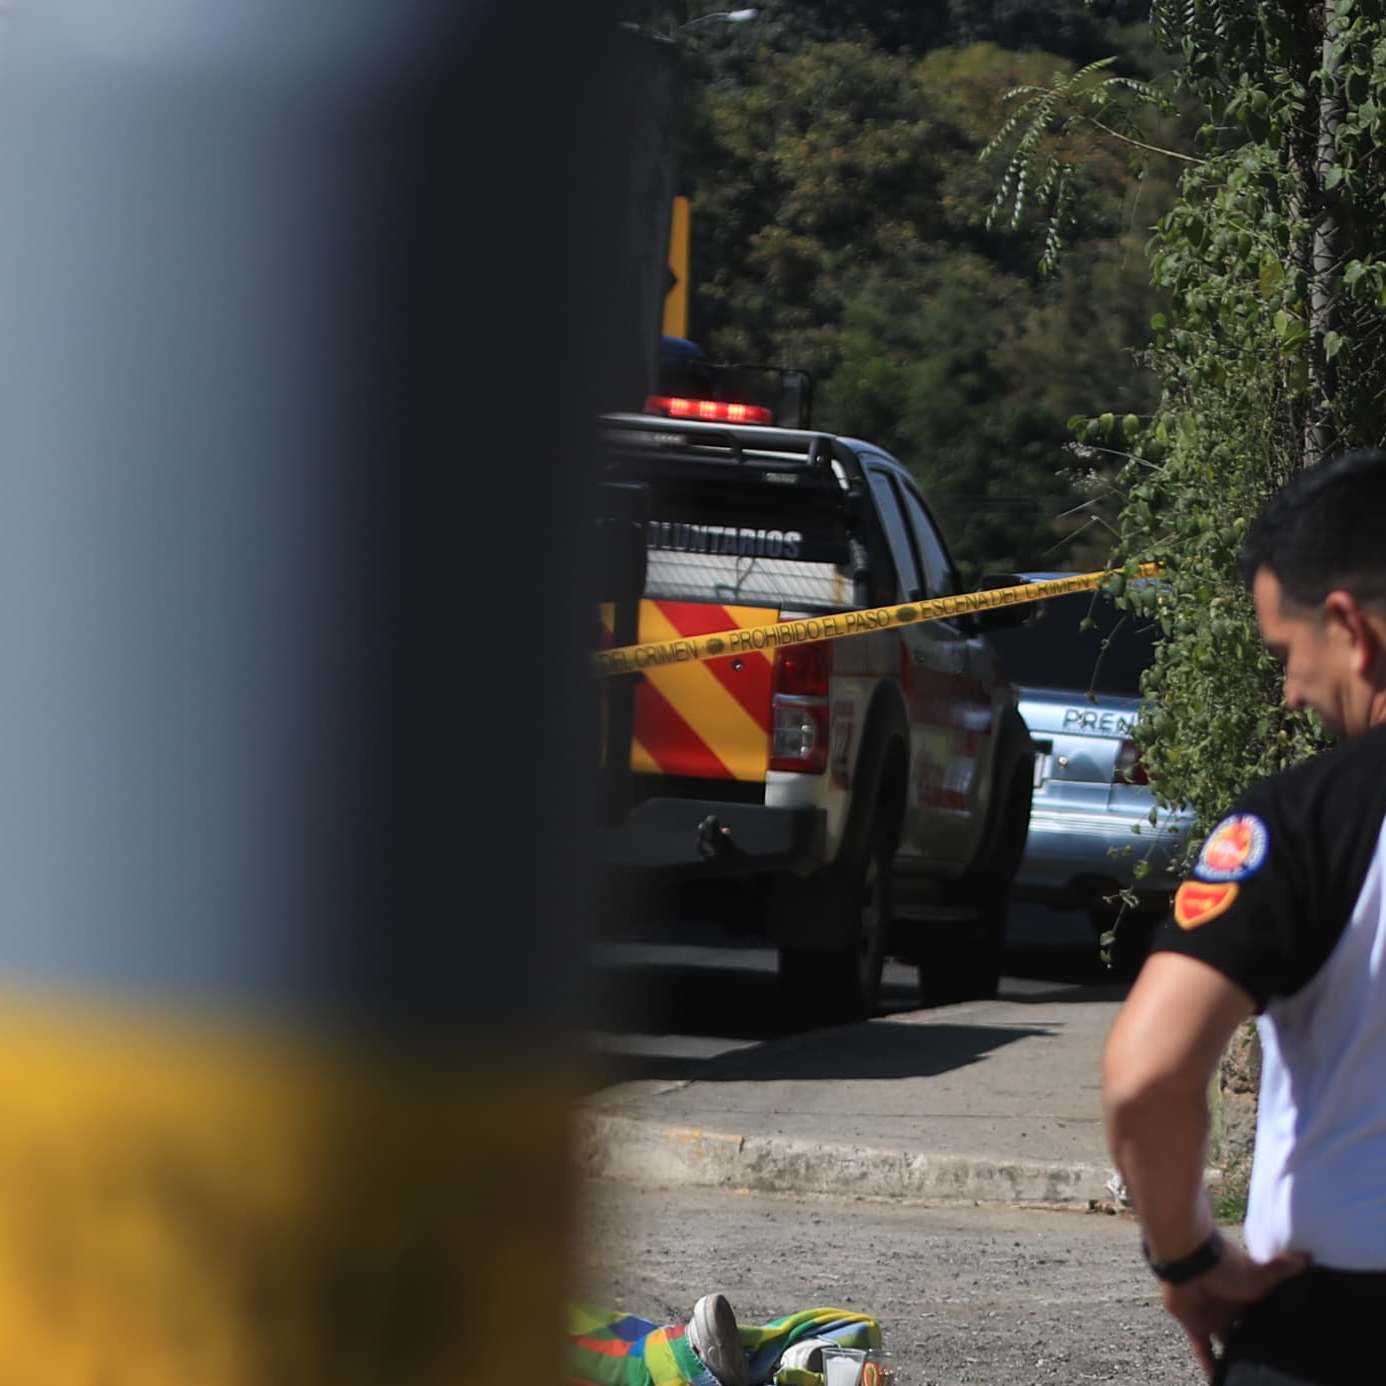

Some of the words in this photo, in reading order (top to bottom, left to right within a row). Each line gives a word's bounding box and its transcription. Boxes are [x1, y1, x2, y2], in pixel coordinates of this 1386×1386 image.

[646, 519, 803, 559] OLUNTARIOS
[633, 642, 699, 668] CRIMEN
[729, 619, 821, 652] PROHIBIDO
[822, 616, 844, 638] EL
[846, 608, 891, 633] PASO
[920, 592, 990, 619] ESCENA
[1062, 708, 1134, 735] PREN
